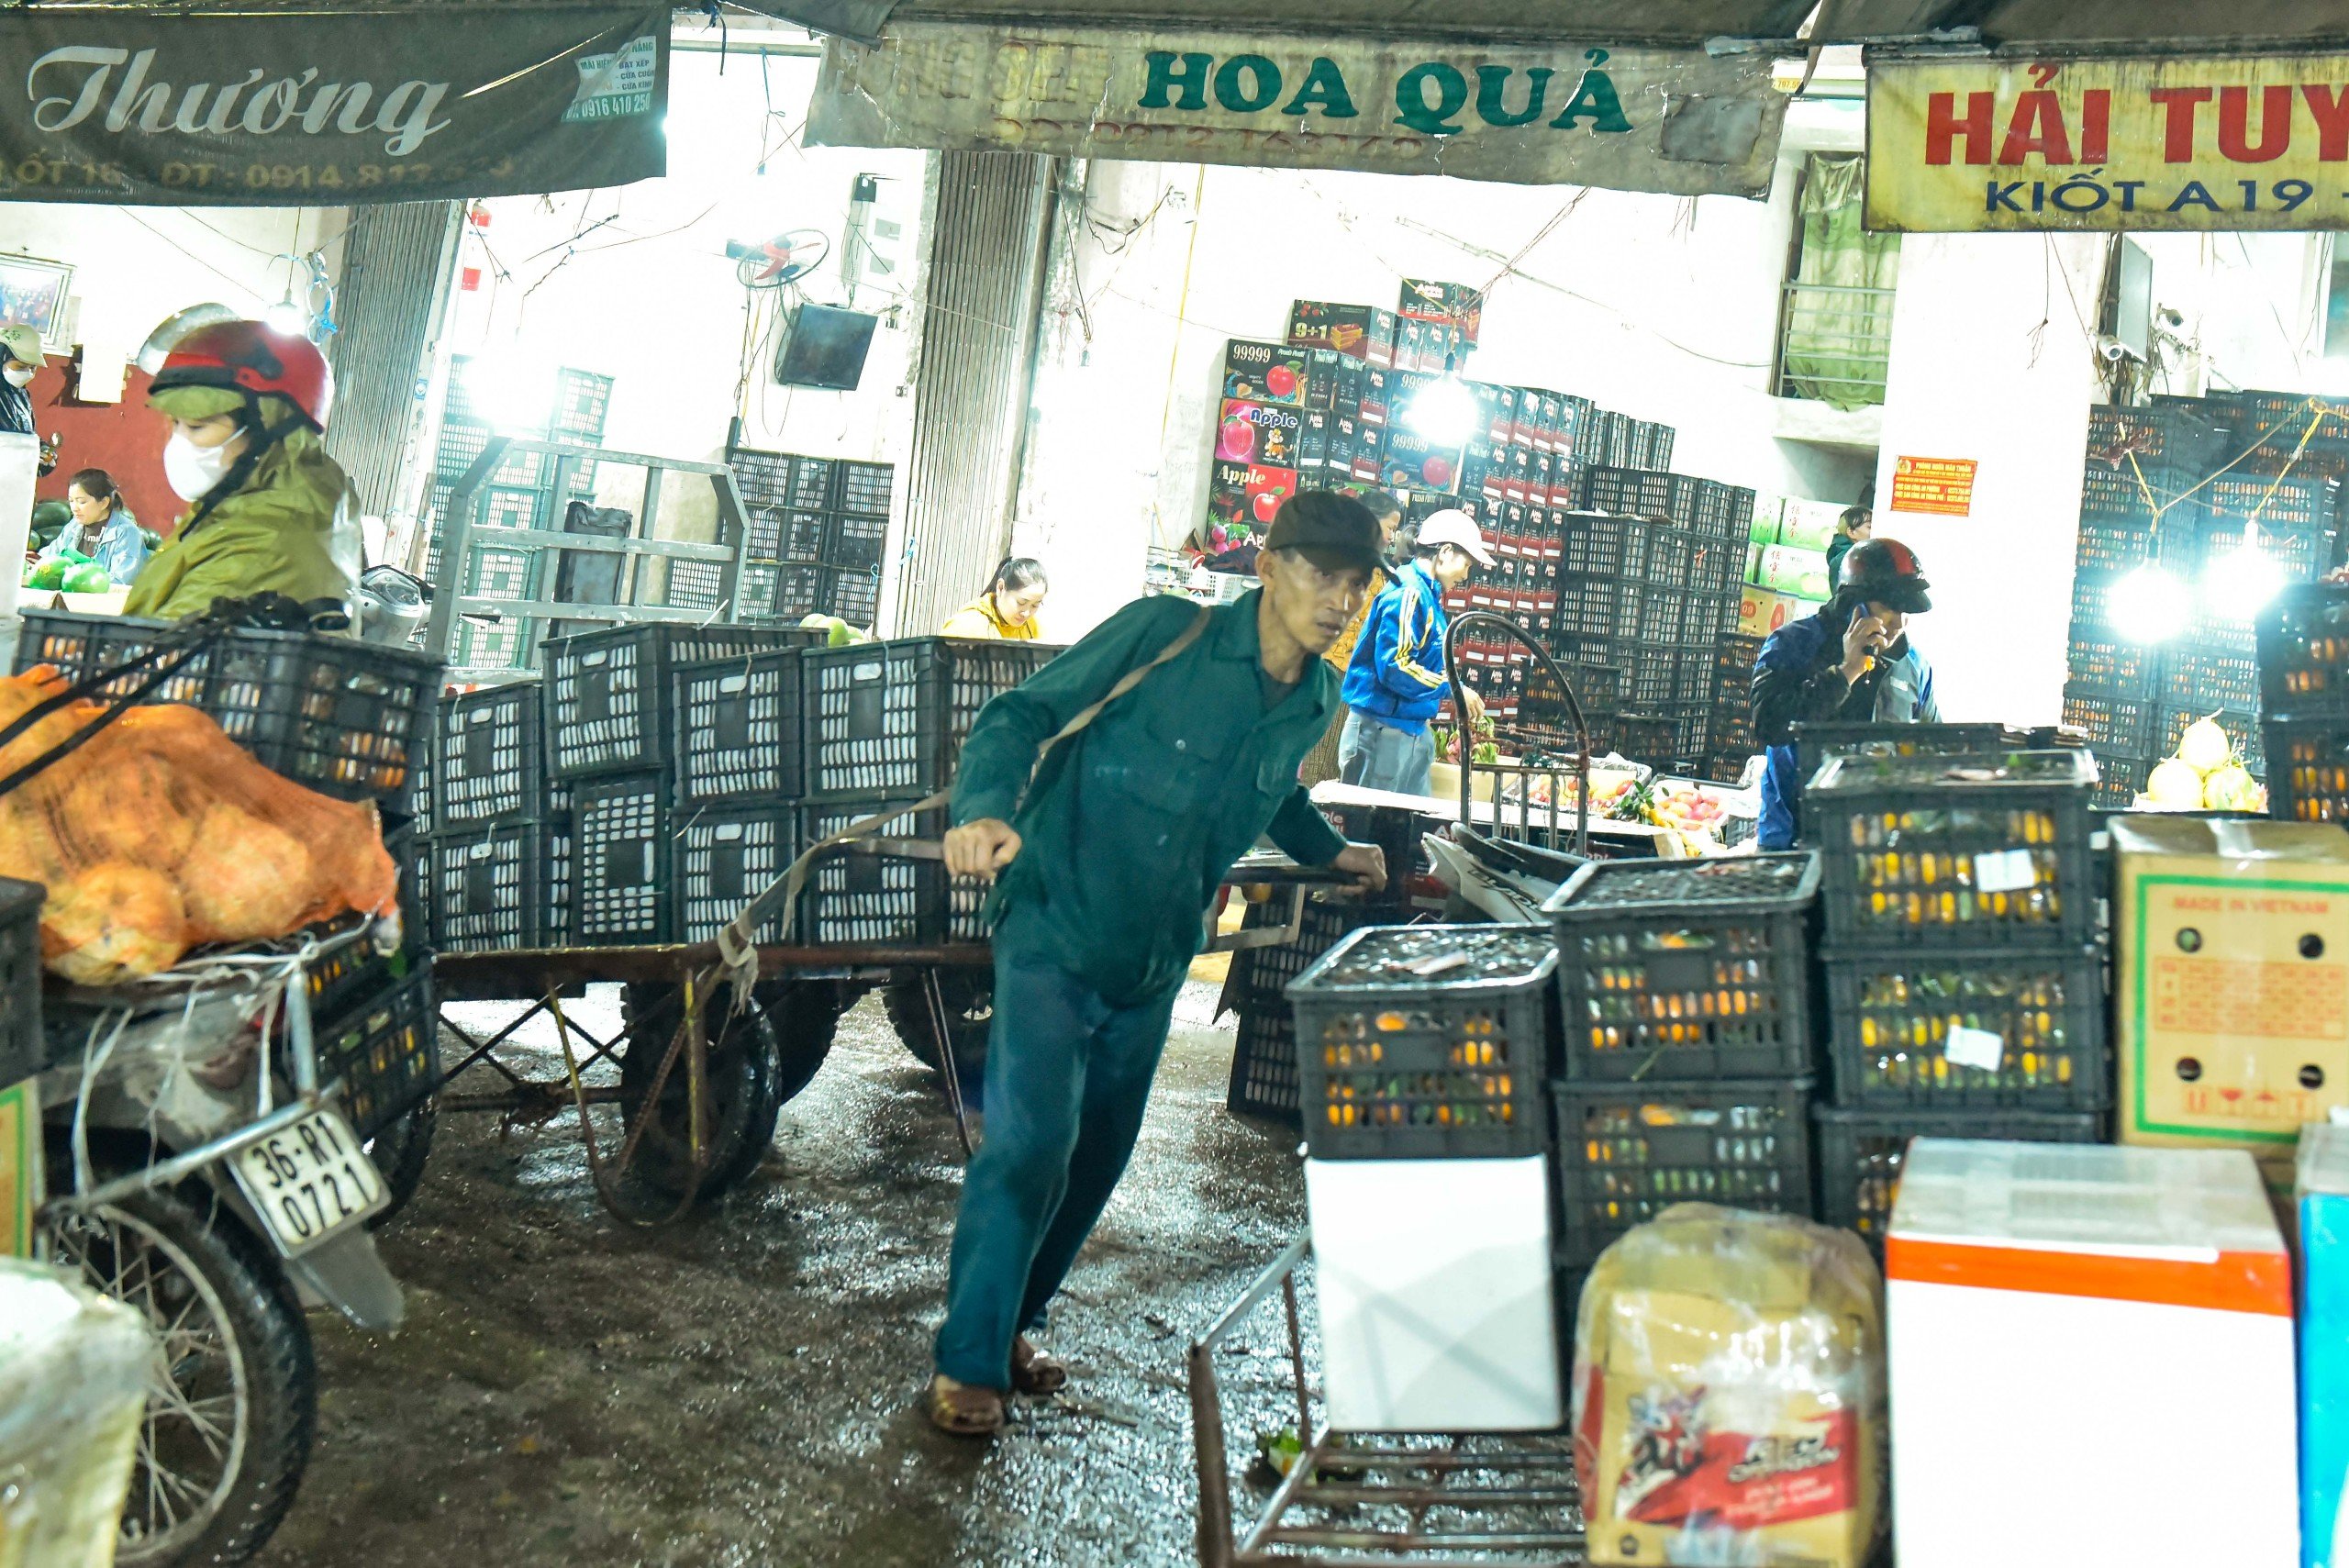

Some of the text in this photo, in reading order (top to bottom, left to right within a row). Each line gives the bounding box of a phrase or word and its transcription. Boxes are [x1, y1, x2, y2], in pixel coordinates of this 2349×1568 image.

[28, 45, 454, 157] Thương
[582, 97, 610, 117] 0916
[612, 95, 631, 115] 410
[1137, 50, 1360, 118] HOA
[1391, 48, 1634, 135] QUẢ
[1924, 62, 2111, 166] HẢI
[0, 148, 69, 184] ỐT
[1985, 168, 2315, 213] KIỐT A19
[1295, 321, 1328, 340] 9+1
[1233, 344, 1271, 363] 99999
[1250, 407, 1298, 428] Apple
[1217, 465, 1266, 486] Apple
[1243, 530, 1266, 550] Ap
[282, 1162, 372, 1238] 0721
